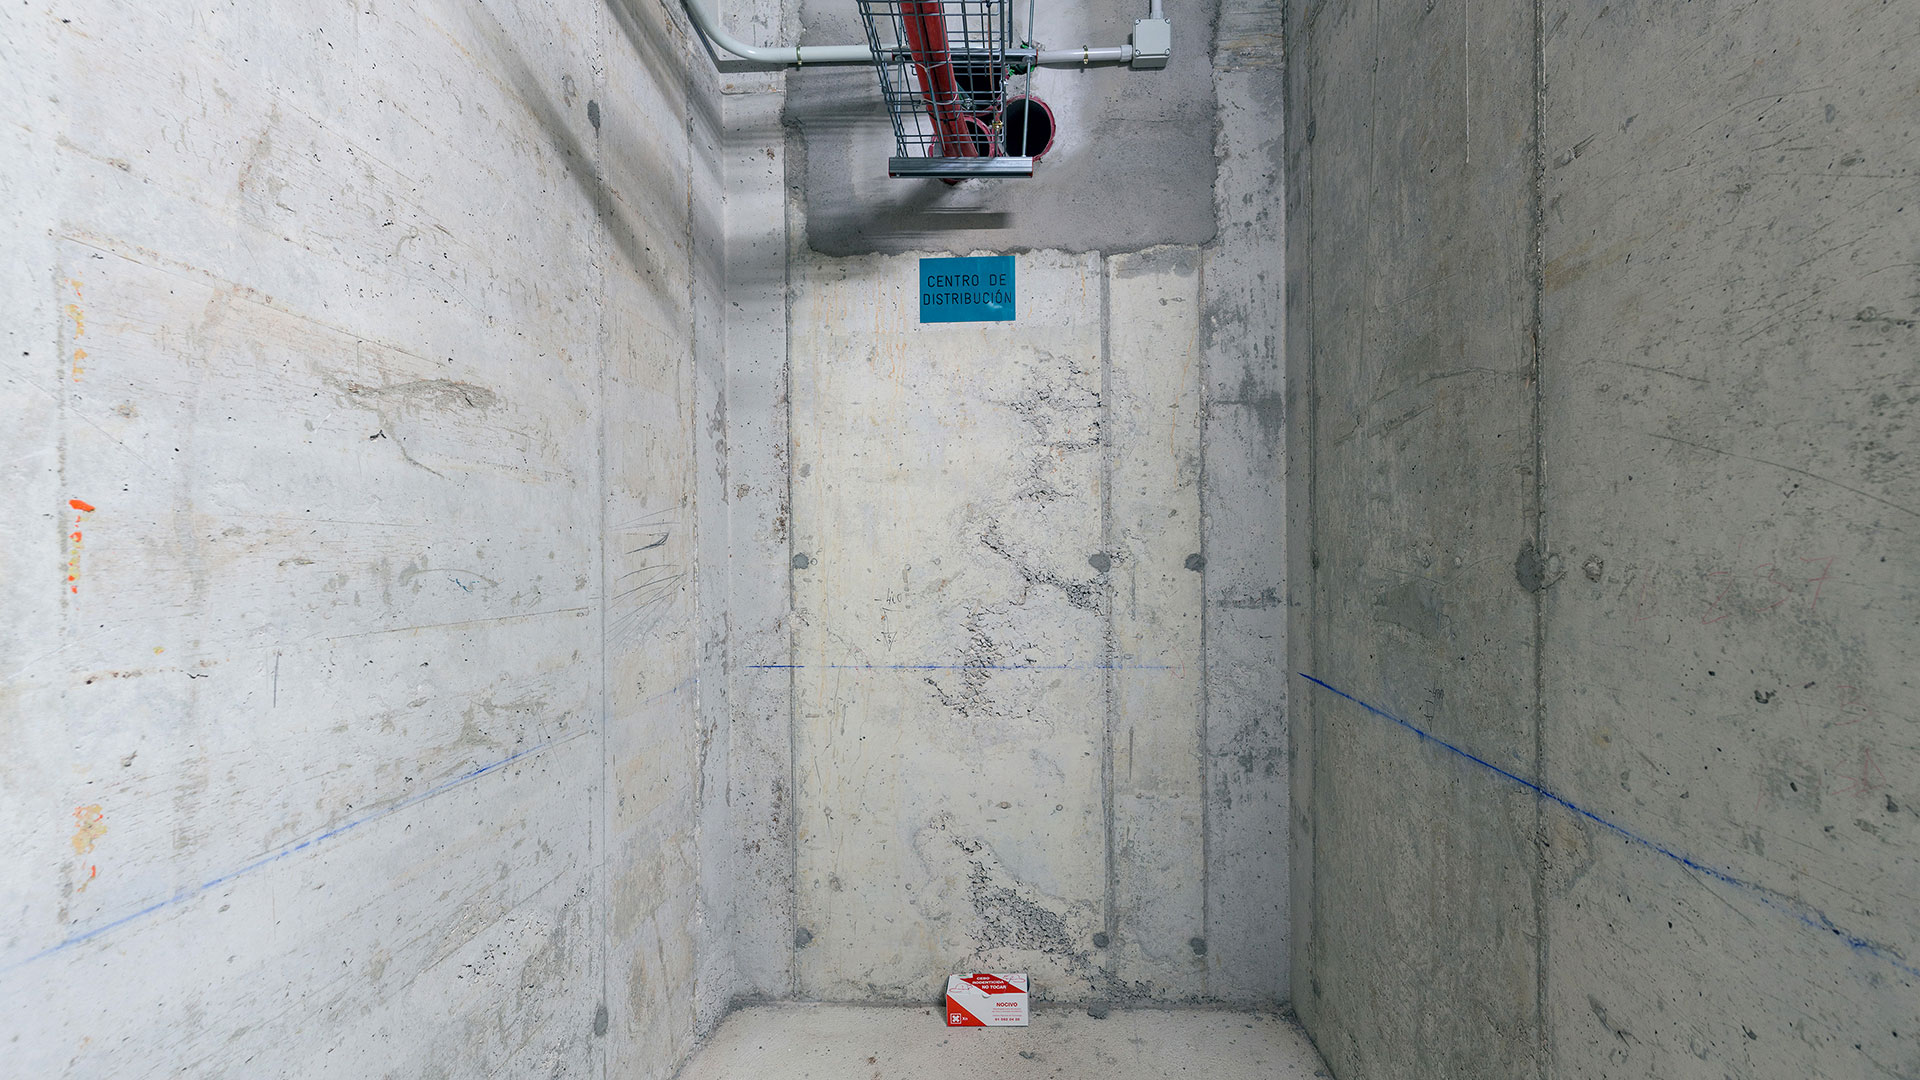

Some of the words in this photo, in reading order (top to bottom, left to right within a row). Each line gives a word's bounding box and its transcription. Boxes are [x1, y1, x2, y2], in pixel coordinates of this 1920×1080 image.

[927, 274, 980, 288] CENTRO
[989, 273, 1007, 287] DE
[923, 289, 1012, 305] DISTRIBUCIÓN
